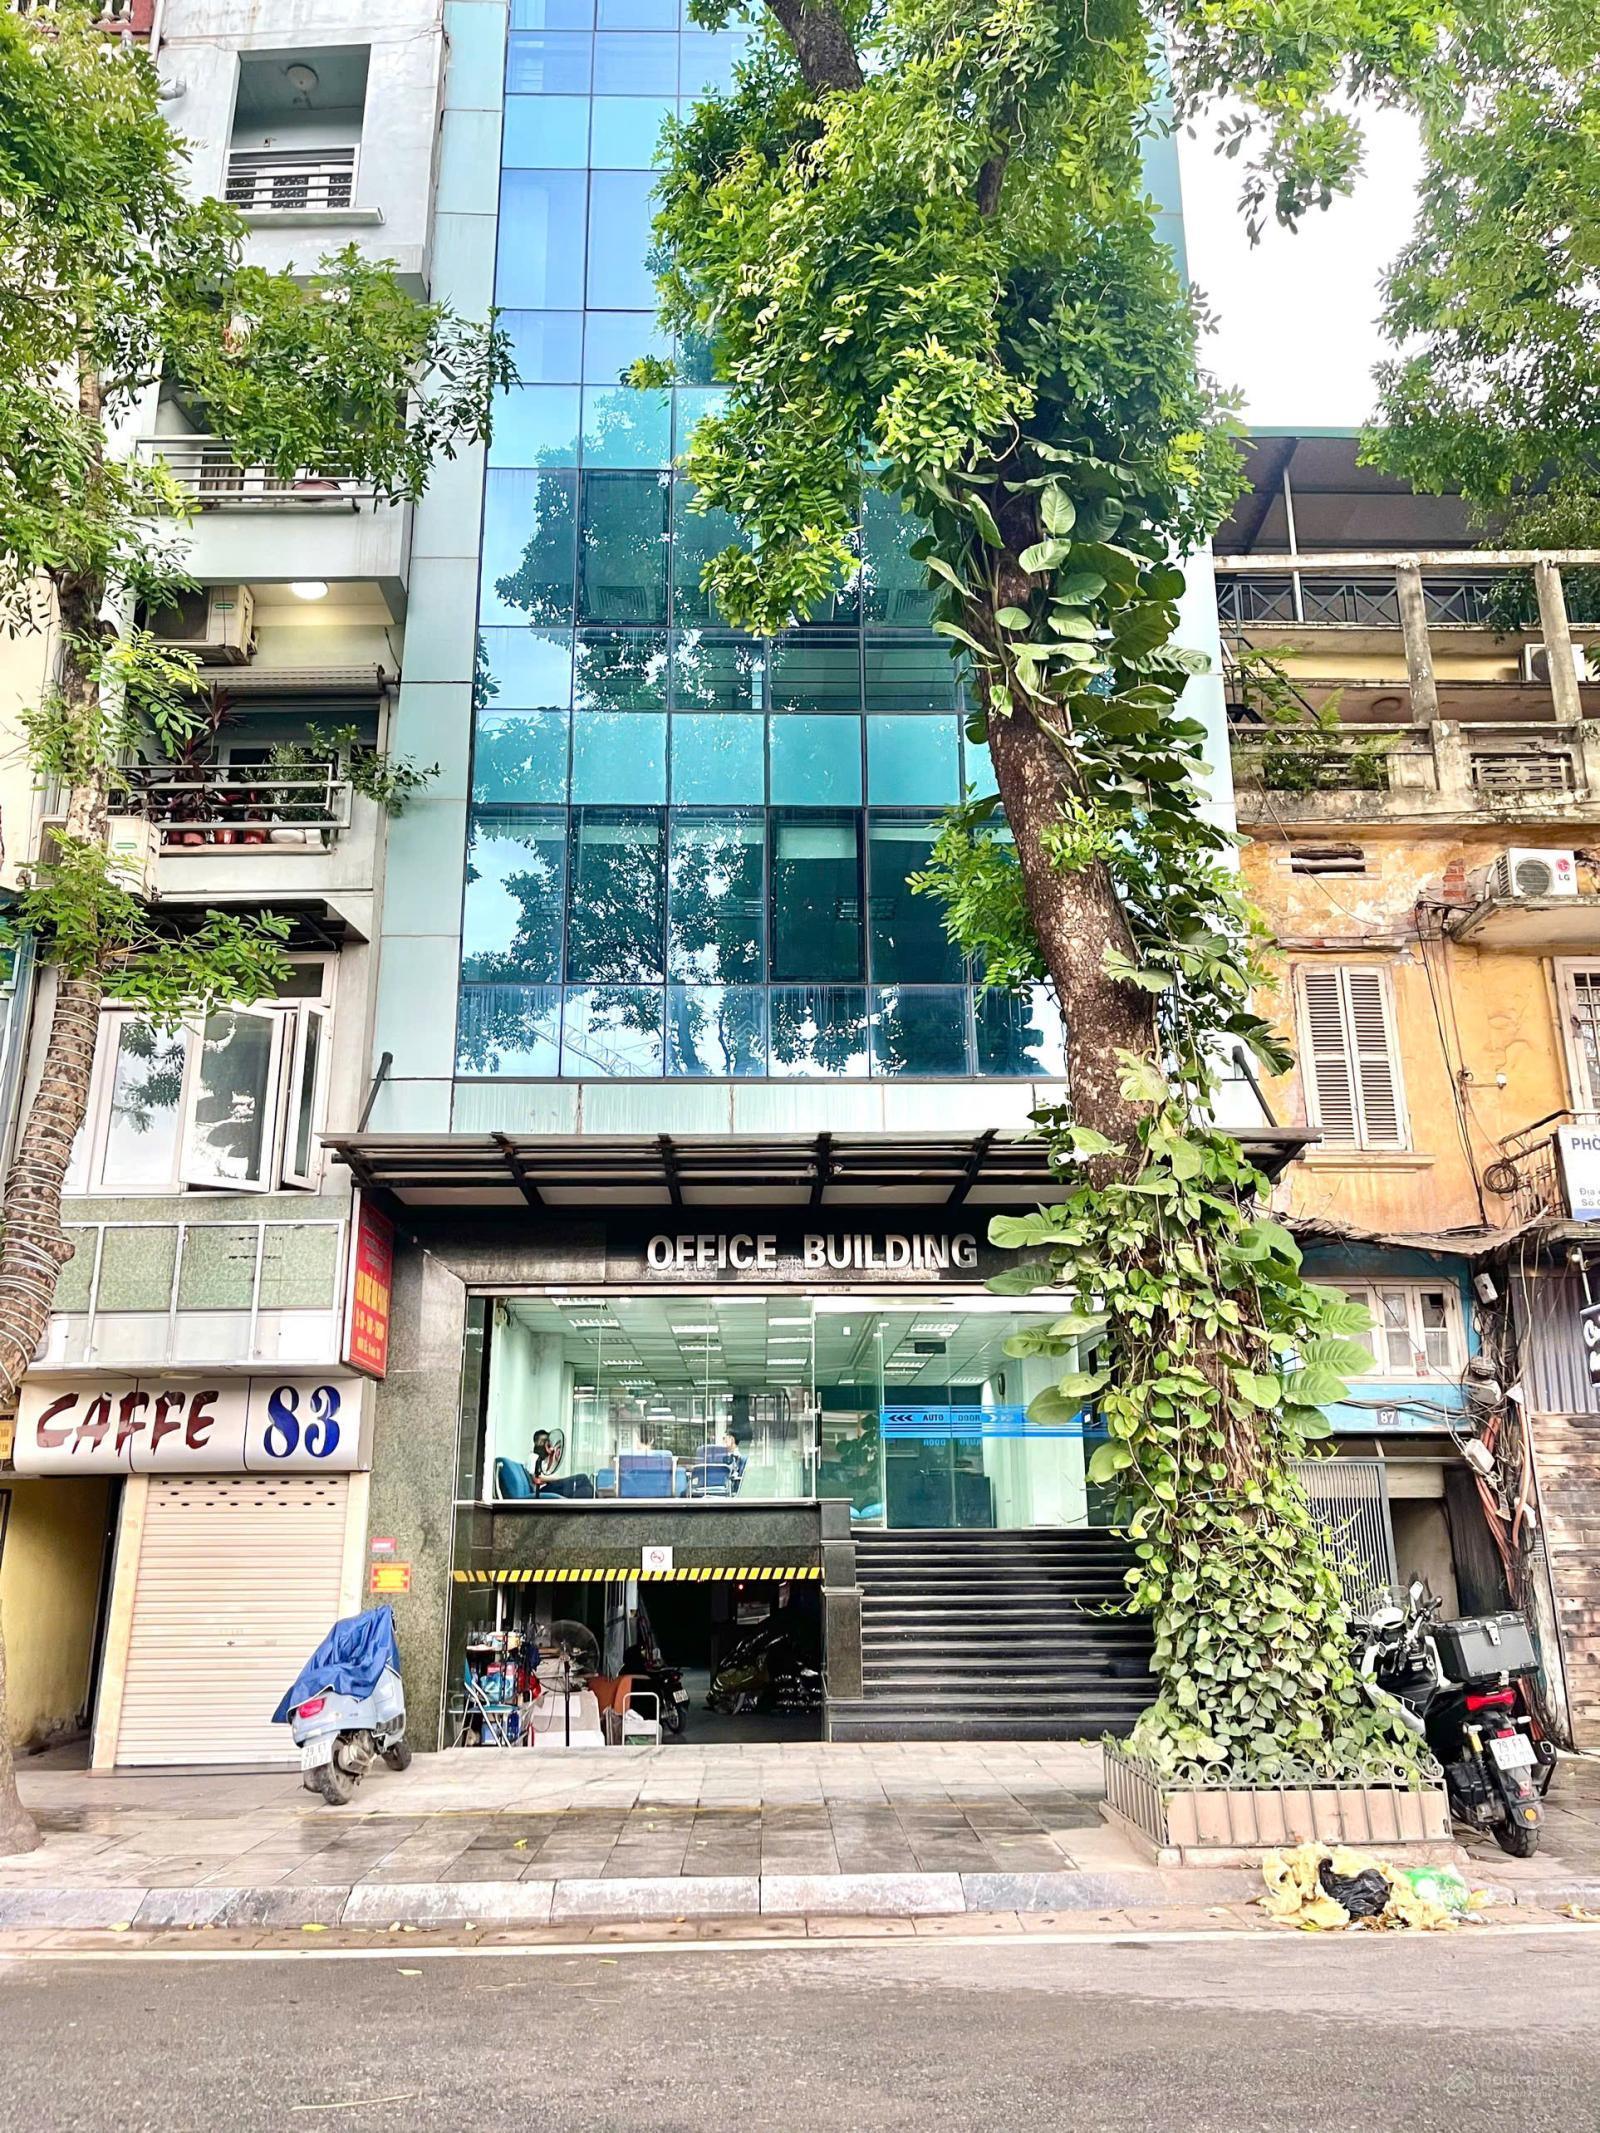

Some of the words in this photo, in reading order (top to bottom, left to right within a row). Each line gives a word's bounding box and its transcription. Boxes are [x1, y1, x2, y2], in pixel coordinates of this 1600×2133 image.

[1558, 873, 1570, 881] LG
[647, 1234, 777, 1270] OFFICE
[804, 1233, 978, 1269] BUILDING
[36, 1390, 219, 1457] CAFFE
[263, 1385, 341, 1458] 83
[1380, 1411, 1395, 1424] 87
